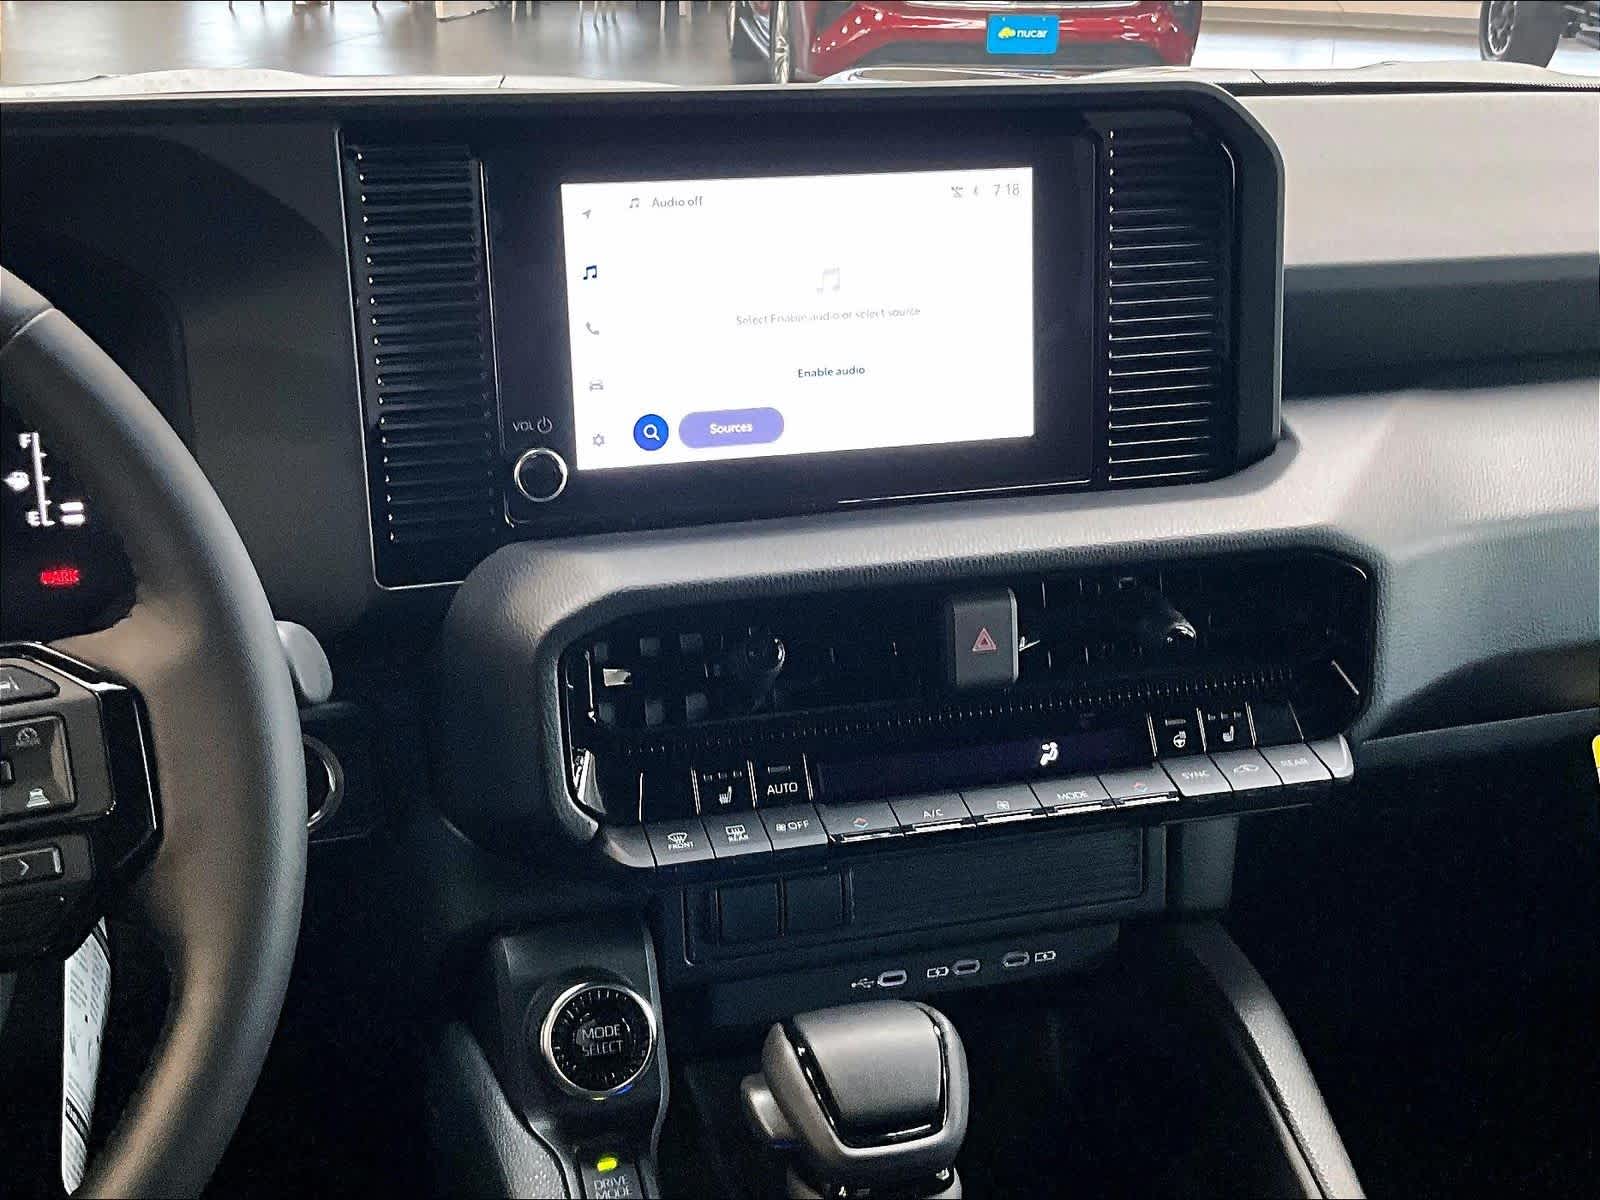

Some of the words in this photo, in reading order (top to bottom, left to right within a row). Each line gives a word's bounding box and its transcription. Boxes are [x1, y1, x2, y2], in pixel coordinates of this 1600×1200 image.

[1016, 29, 1048, 38] nucar
[993, 183, 1020, 196] 718
[652, 196, 685, 208] Audio
[687, 195, 703, 207] off
[736, 314, 768, 325] Select
[797, 368, 833, 378] Enable
[834, 365, 866, 376] audio
[512, 420, 534, 432] VOL
[709, 422, 753, 434] Sources
[19, 432, 32, 449] F
[26, 510, 42, 527] E
[1181, 769, 1210, 780] SYNC
[767, 782, 798, 795] AUTO
[1056, 790, 1089, 801] MODE
[922, 808, 944, 819] A/C
[787, 820, 809, 831] OFF
[667, 841, 695, 850] FRONT
[582, 1023, 621, 1040] MODE
[581, 1039, 624, 1057] SELECT
[593, 1174, 630, 1191] DRIVE
[595, 1185, 633, 1199] MODE
